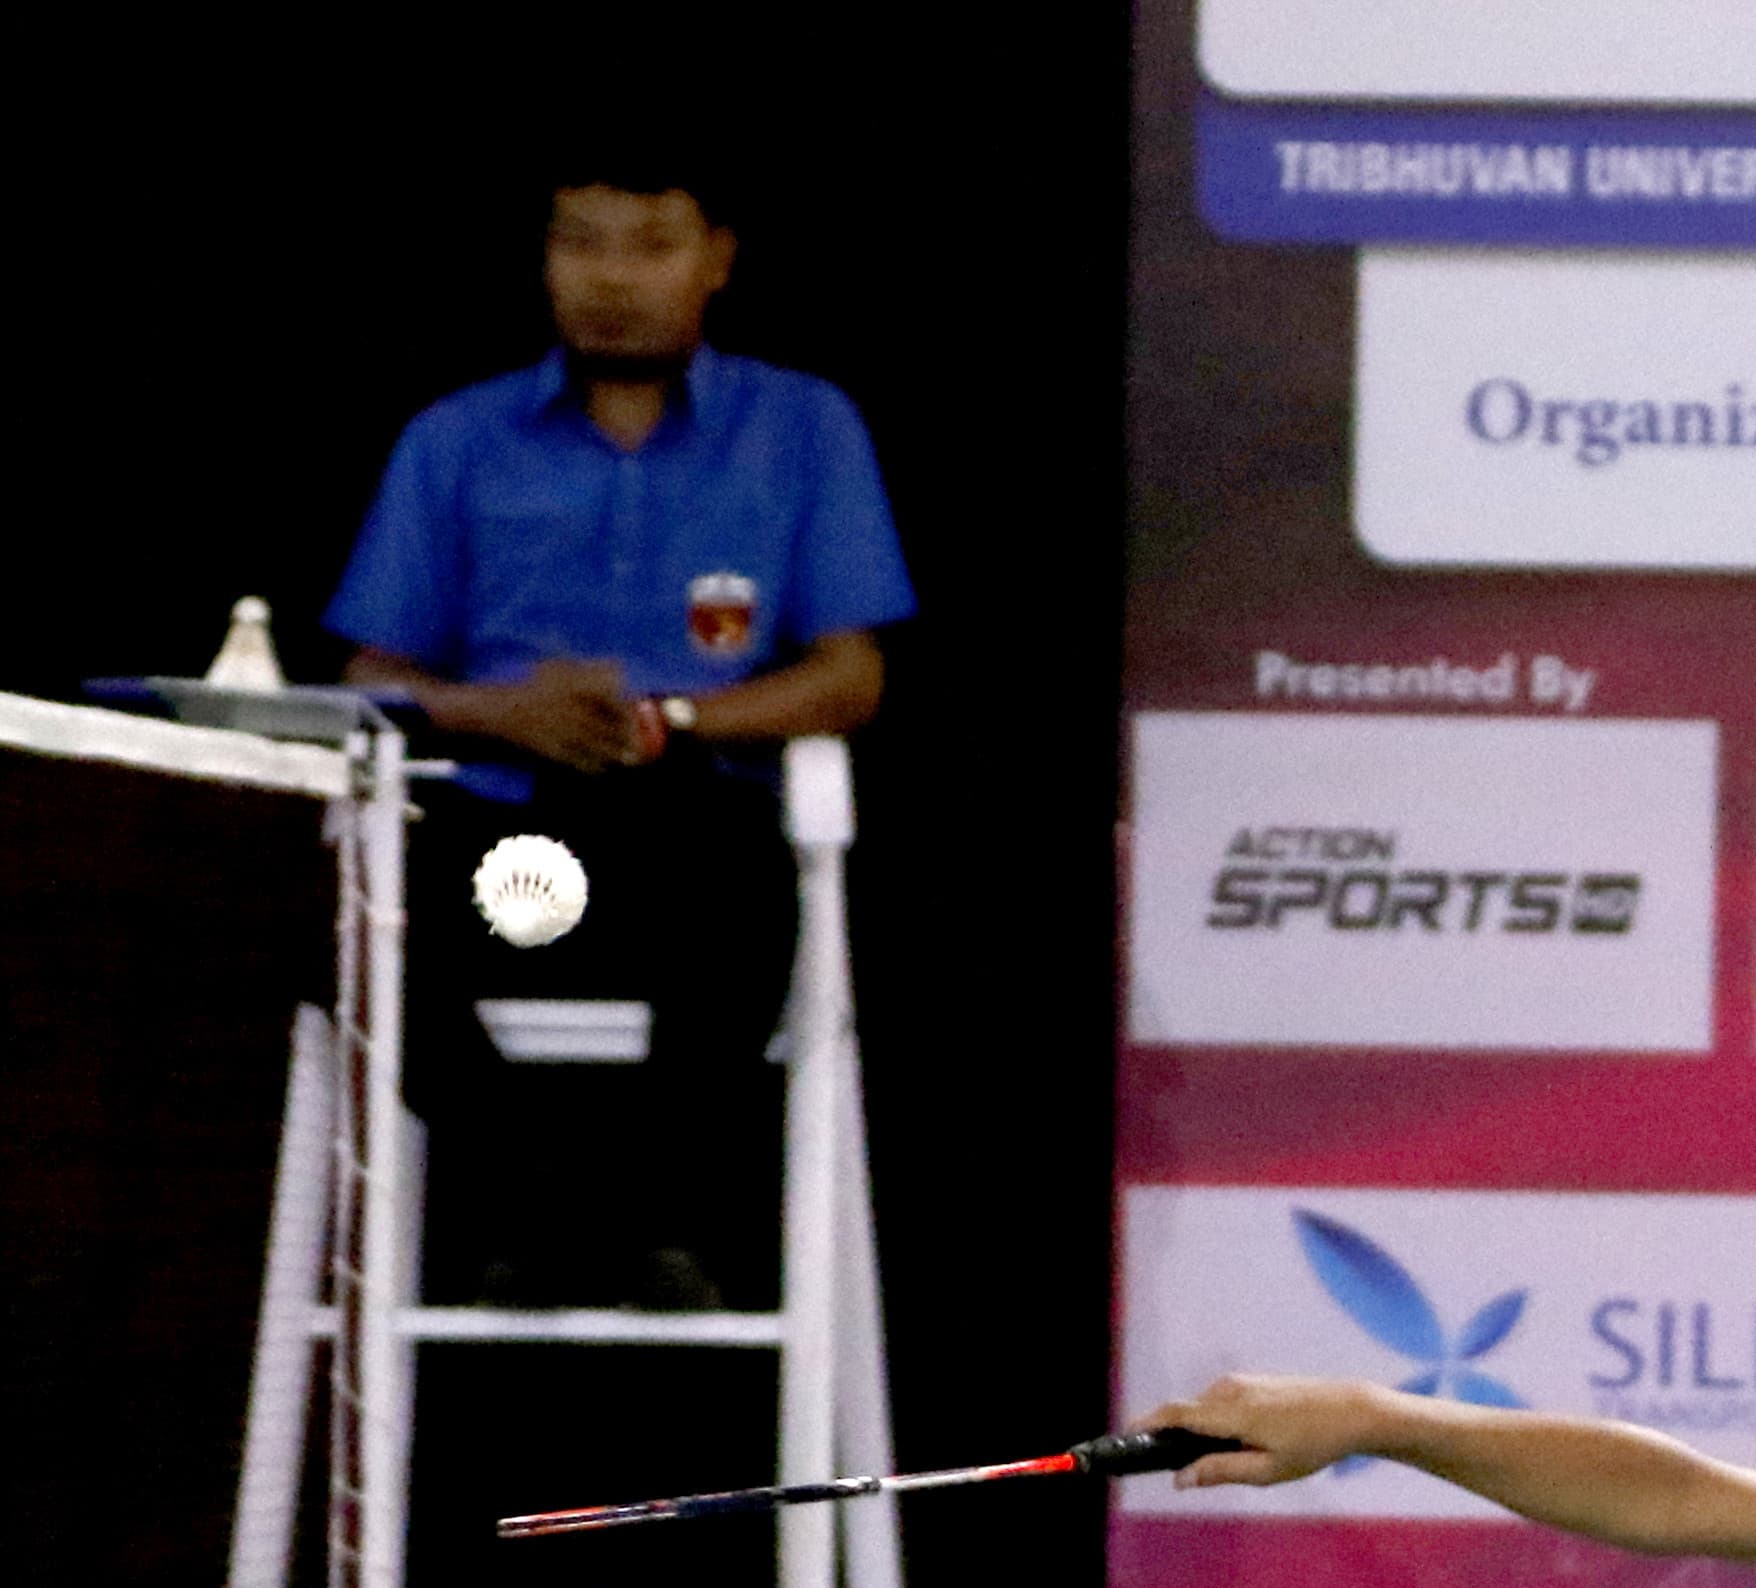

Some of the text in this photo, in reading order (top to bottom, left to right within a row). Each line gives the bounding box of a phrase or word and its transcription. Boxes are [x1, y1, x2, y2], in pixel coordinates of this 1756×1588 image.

[1275, 141, 1569, 195] TRIBHUVAN
[1255, 651, 1595, 711] Presented By
[1228, 826, 1396, 860] ACTION
[1207, 869, 1569, 931] SPORTS
